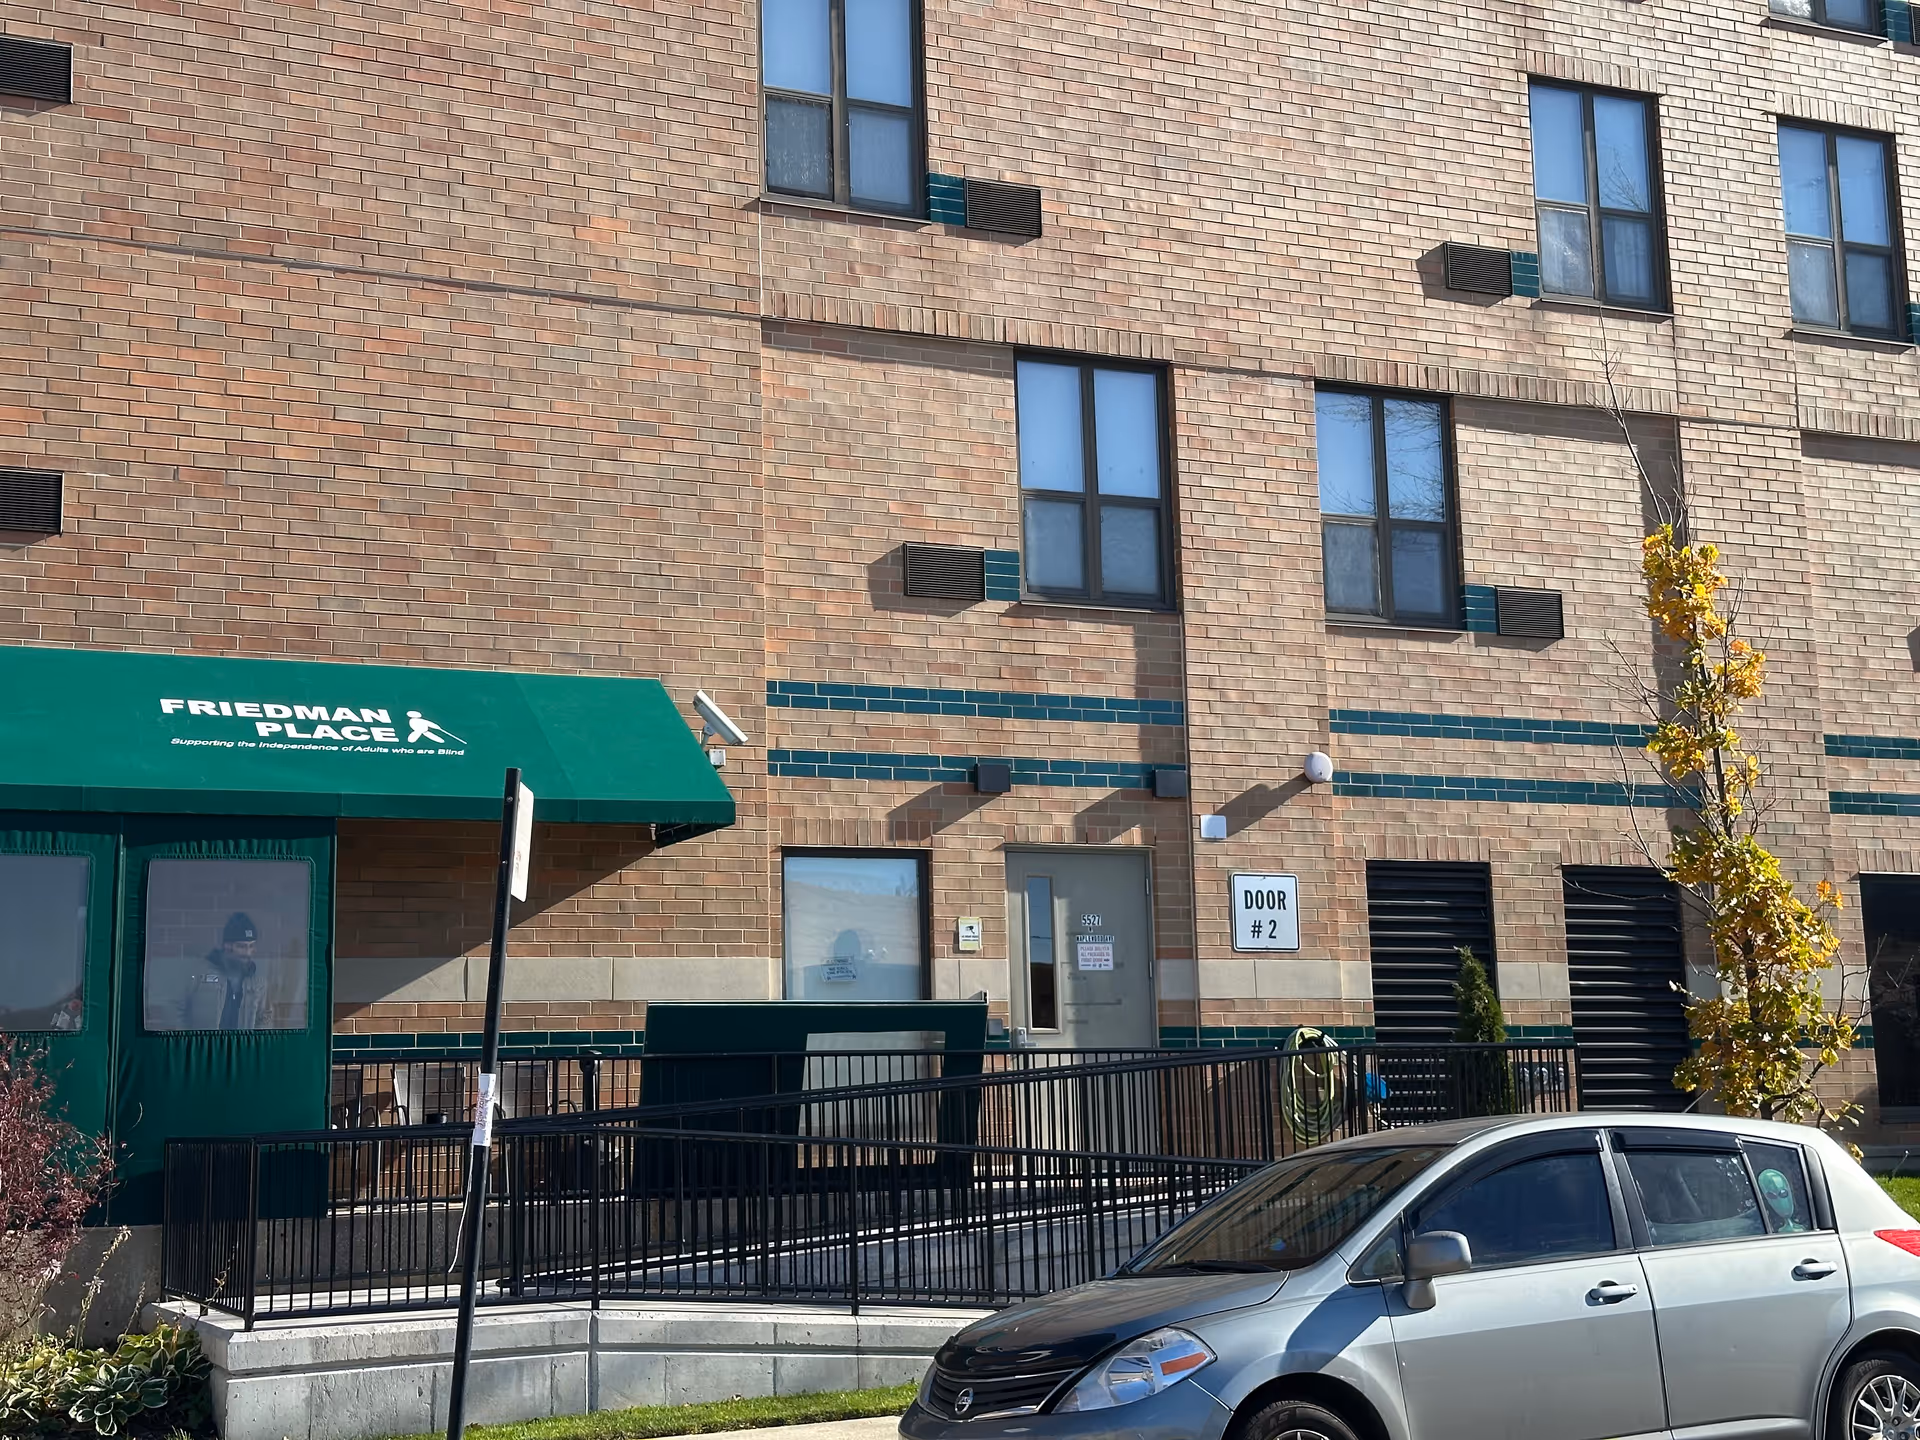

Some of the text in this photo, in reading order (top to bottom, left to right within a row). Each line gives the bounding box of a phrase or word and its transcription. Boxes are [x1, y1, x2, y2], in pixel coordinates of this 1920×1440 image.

[160, 698, 392, 723] FRIEDMAN
[255, 721, 400, 742] PLACE
[171, 738, 235, 748] Supporting
[237, 740, 256, 748] the
[258, 741, 339, 751] Independence
[341, 744, 355, 752] of
[354, 745, 389, 753] Adults
[392, 747, 415, 755] who
[437, 748, 465, 756] Blind
[1243, 889, 1287, 911] DOOR
[1082, 914, 1101, 926] 5527
